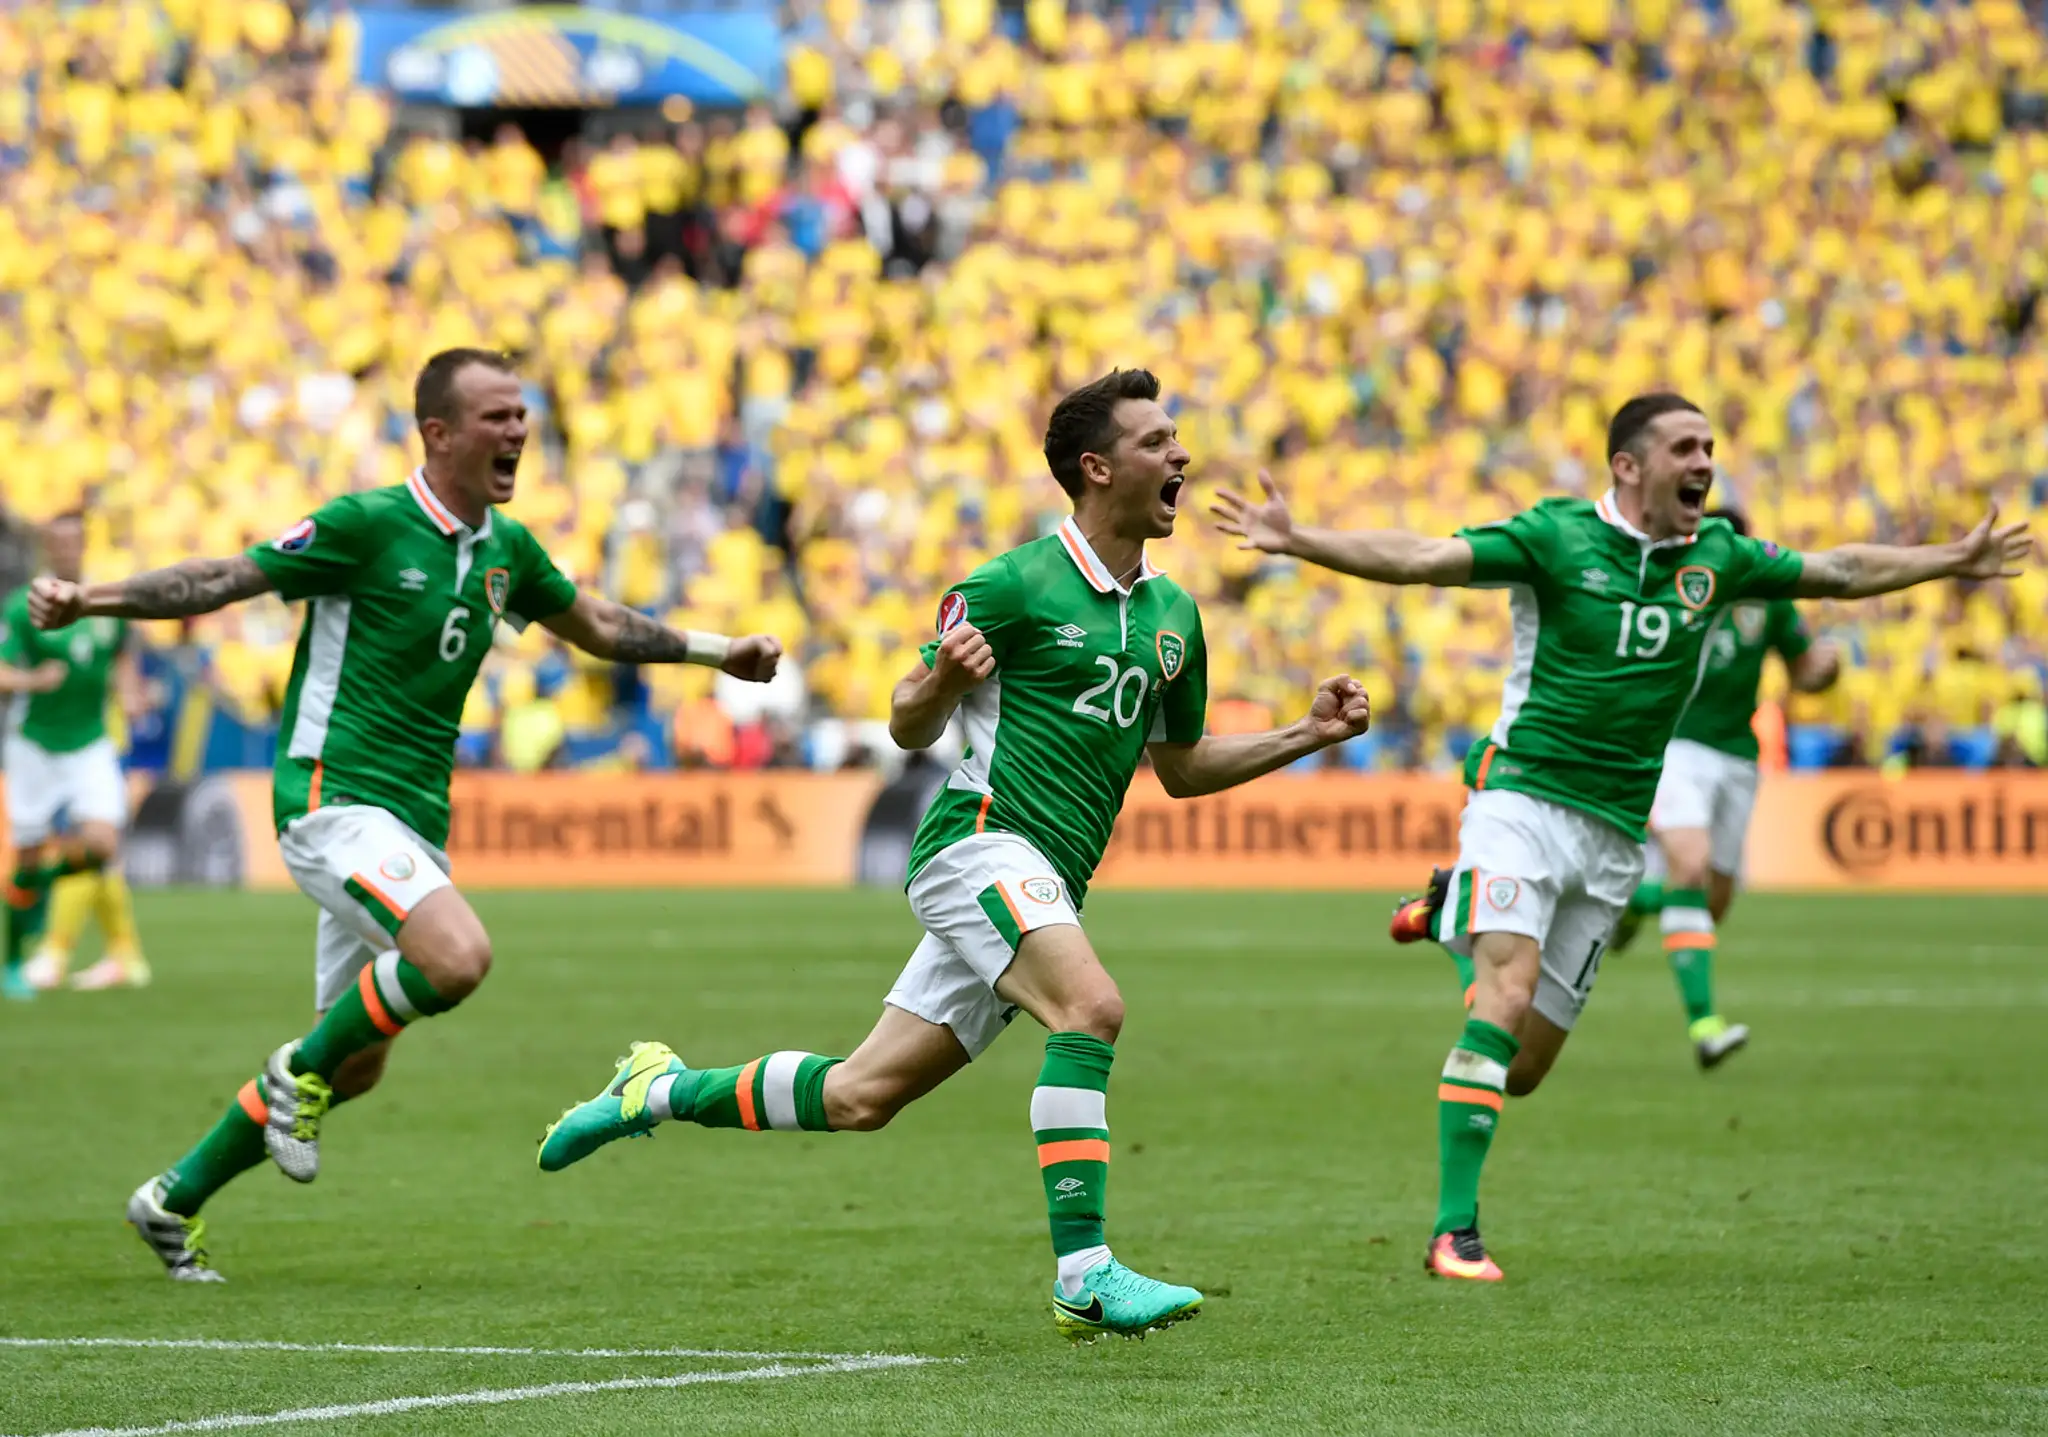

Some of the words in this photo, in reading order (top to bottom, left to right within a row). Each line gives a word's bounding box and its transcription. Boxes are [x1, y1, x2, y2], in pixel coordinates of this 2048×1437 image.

[438, 605, 471, 663] 6
[1057, 638, 1084, 648] umbro
[1615, 600, 1671, 659] 19
[1072, 655, 1149, 729] 20
[1112, 796, 1467, 855] ntinenta
[1571, 938, 1606, 994] 1
